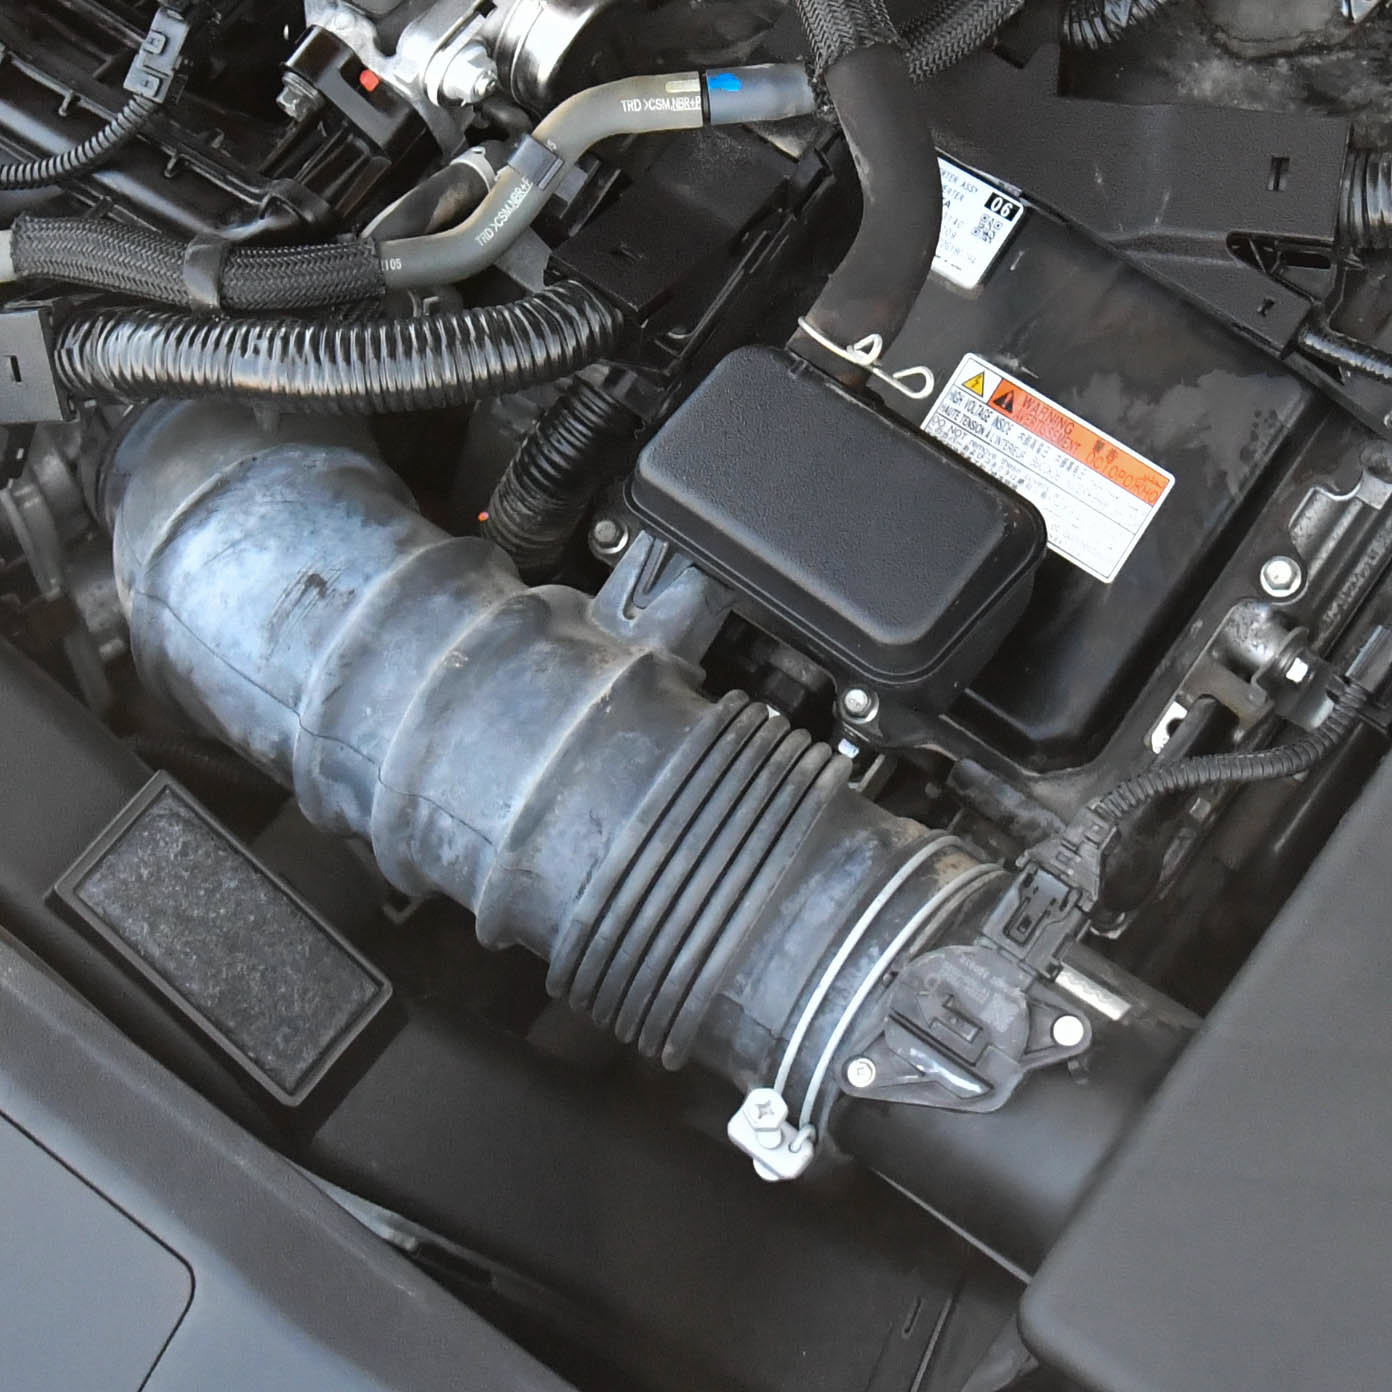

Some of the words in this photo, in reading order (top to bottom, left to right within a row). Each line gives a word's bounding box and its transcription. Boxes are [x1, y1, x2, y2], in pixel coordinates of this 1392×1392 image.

[620, 98, 642, 113] TRD
[990, 196, 1013, 218] 06
[474, 225, 495, 248] TRD
[958, 410, 986, 436] TENSION
[964, 397, 994, 425] VOLTAGE
[1021, 395, 1076, 436] WARNING
